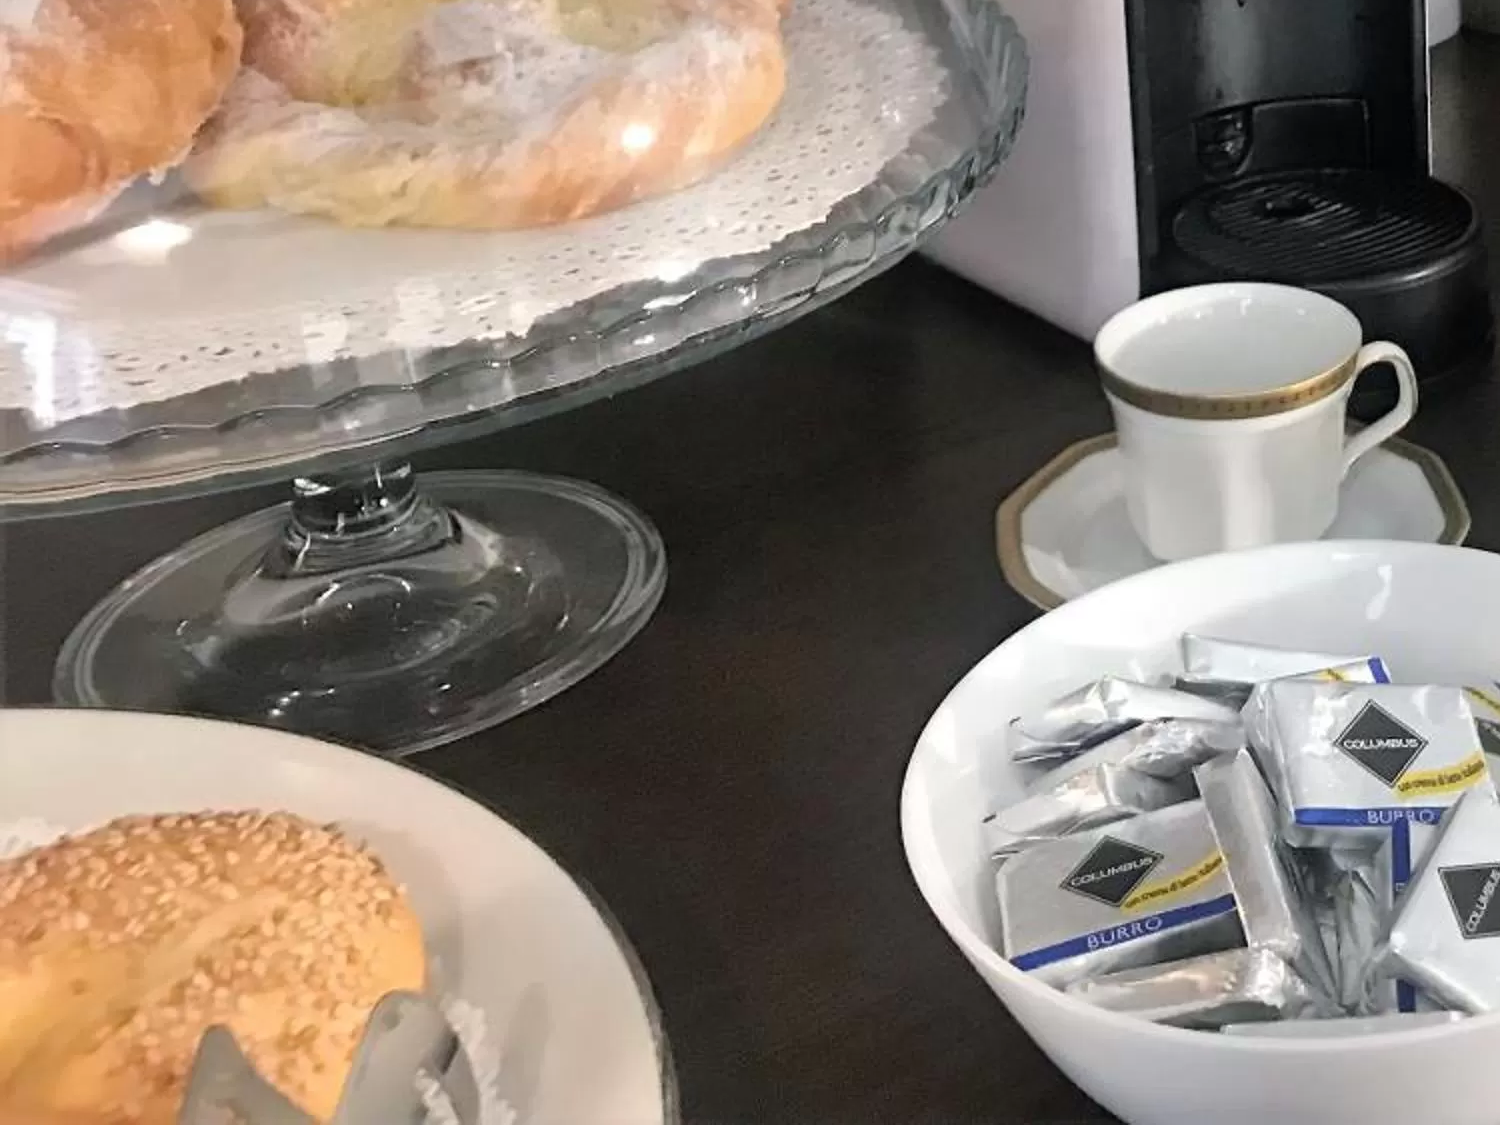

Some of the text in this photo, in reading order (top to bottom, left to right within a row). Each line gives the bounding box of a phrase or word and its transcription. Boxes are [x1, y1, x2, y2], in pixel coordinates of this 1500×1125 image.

[1343, 737, 1419, 751] COLUMBUS
[1367, 808, 1435, 824] BURRO
[1070, 856, 1154, 887] COLUMBUS
[1087, 916, 1163, 950] BURRO
